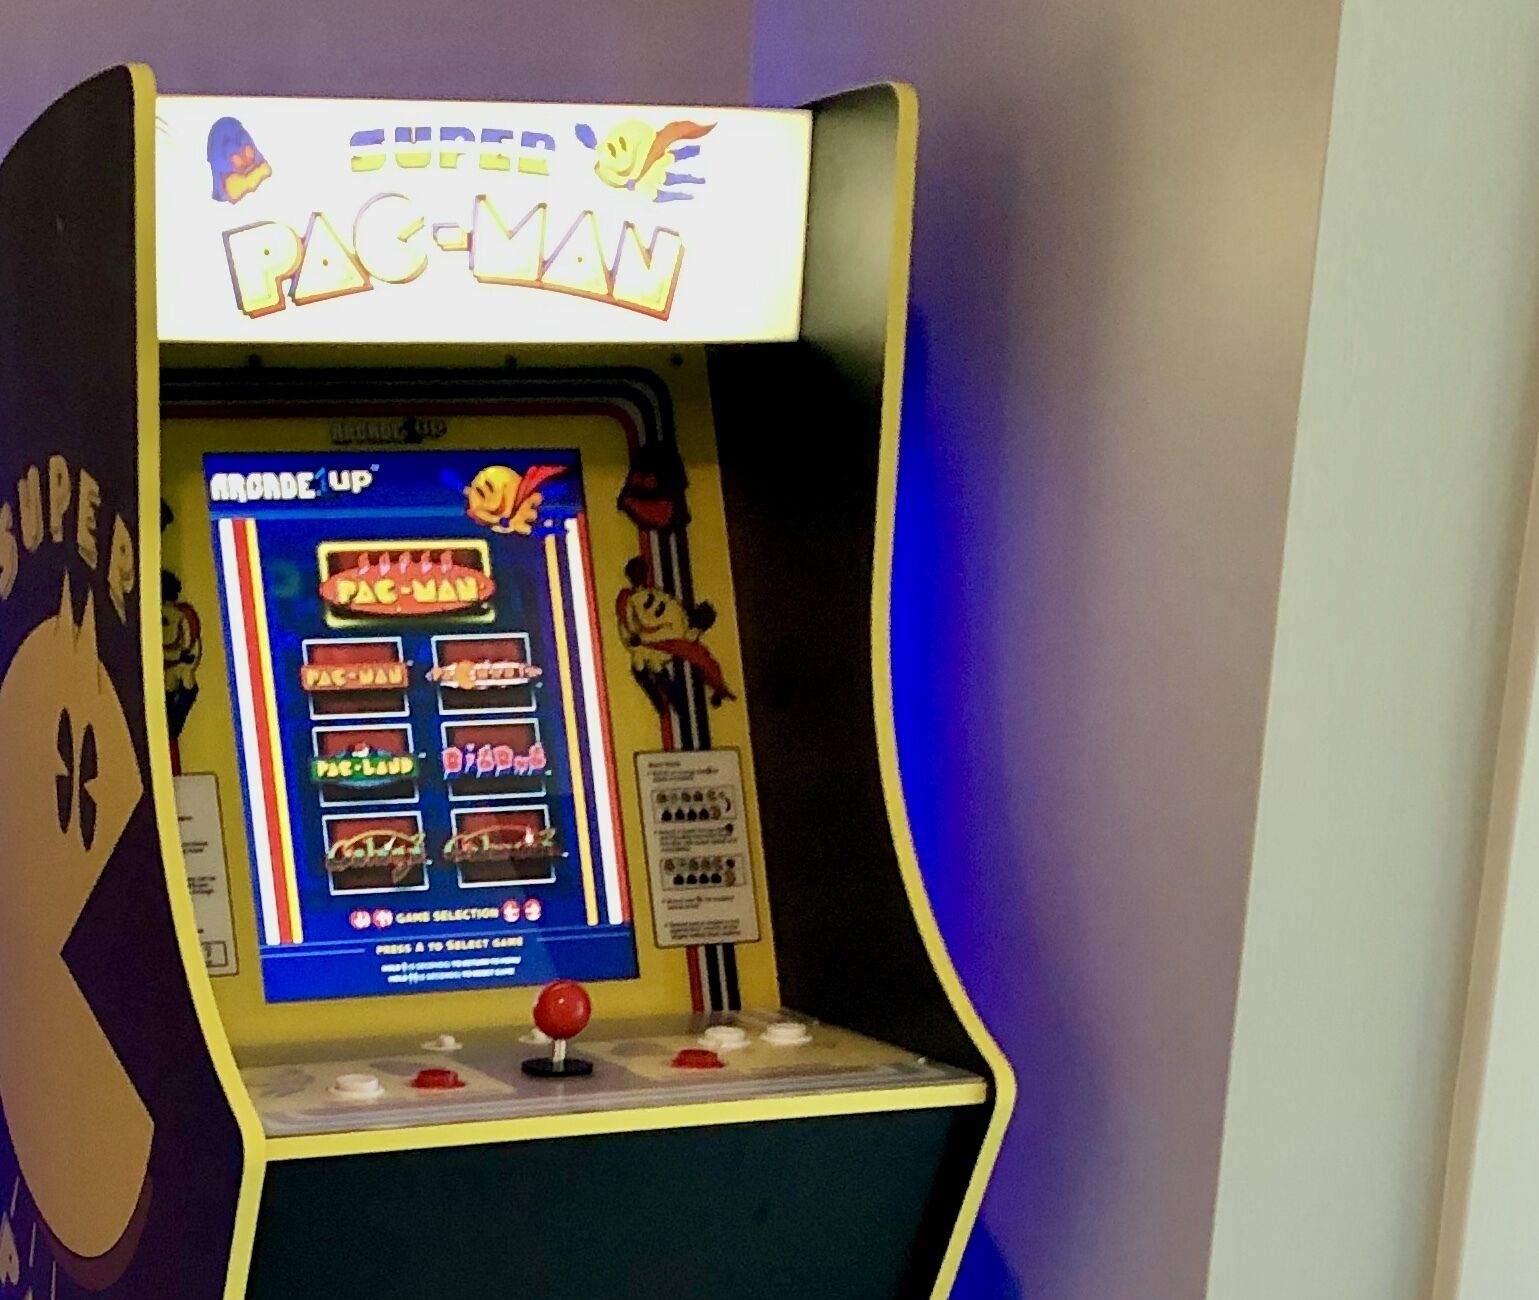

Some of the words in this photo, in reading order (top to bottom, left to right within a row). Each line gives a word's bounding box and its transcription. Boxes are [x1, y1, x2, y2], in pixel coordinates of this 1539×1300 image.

[349, 126, 556, 176] SUPER
[222, 192, 685, 321] PAC-MAN
[336, 576, 479, 604] PAC-MAN
[306, 667, 403, 687] PAC-MAN
[316, 756, 414, 778] PAC-LAND
[395, 910, 431, 924] GAME
[432, 907, 499, 922] SELECTION
[428, 941, 444, 952] TO
[445, 938, 490, 951] SELECT
[492, 936, 524, 948] GAME
